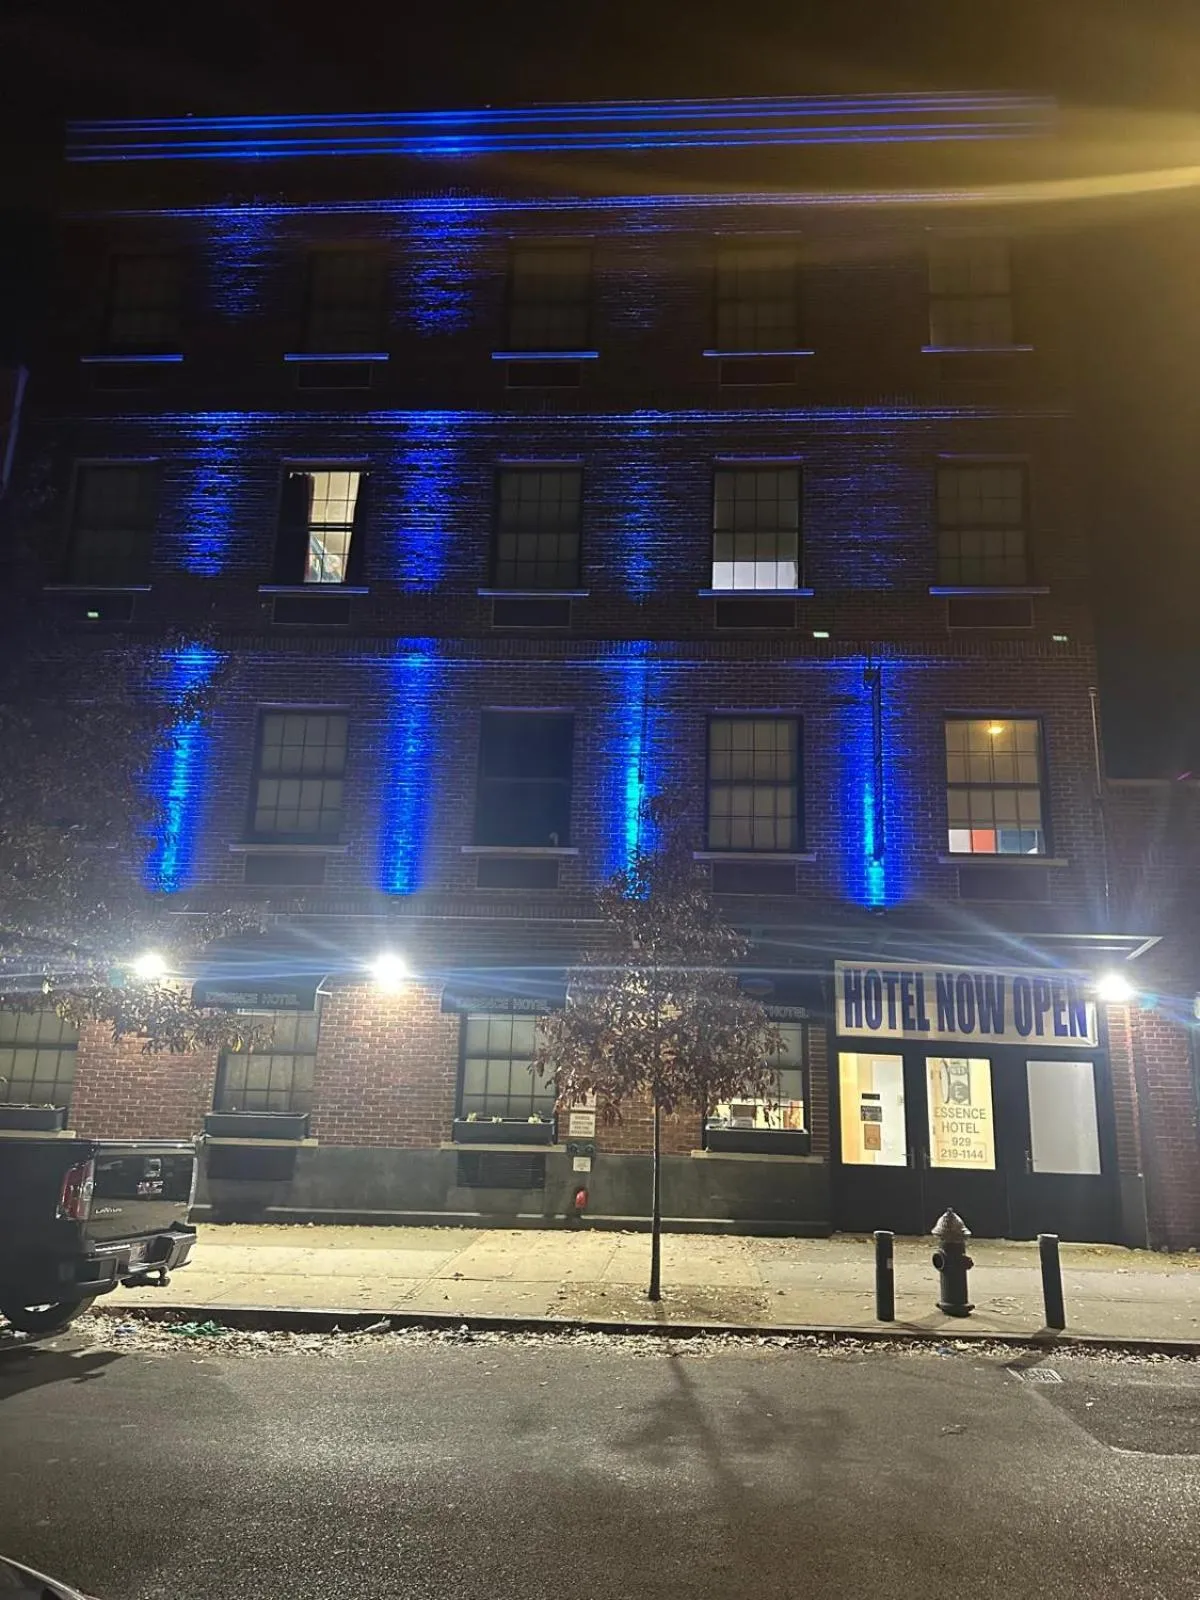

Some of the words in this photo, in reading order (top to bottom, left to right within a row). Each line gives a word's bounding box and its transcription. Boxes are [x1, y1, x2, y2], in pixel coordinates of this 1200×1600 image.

[844, 968, 931, 1032] HOTEL
[935, 972, 1005, 1034] NOW
[1013, 975, 1088, 1038] OPEN
[934, 1106, 987, 1120] ESSENCE
[941, 1121, 980, 1134] HOTEL
[952, 1136, 972, 1147] 929
[940, 1148, 984, 1159] 219-1144
